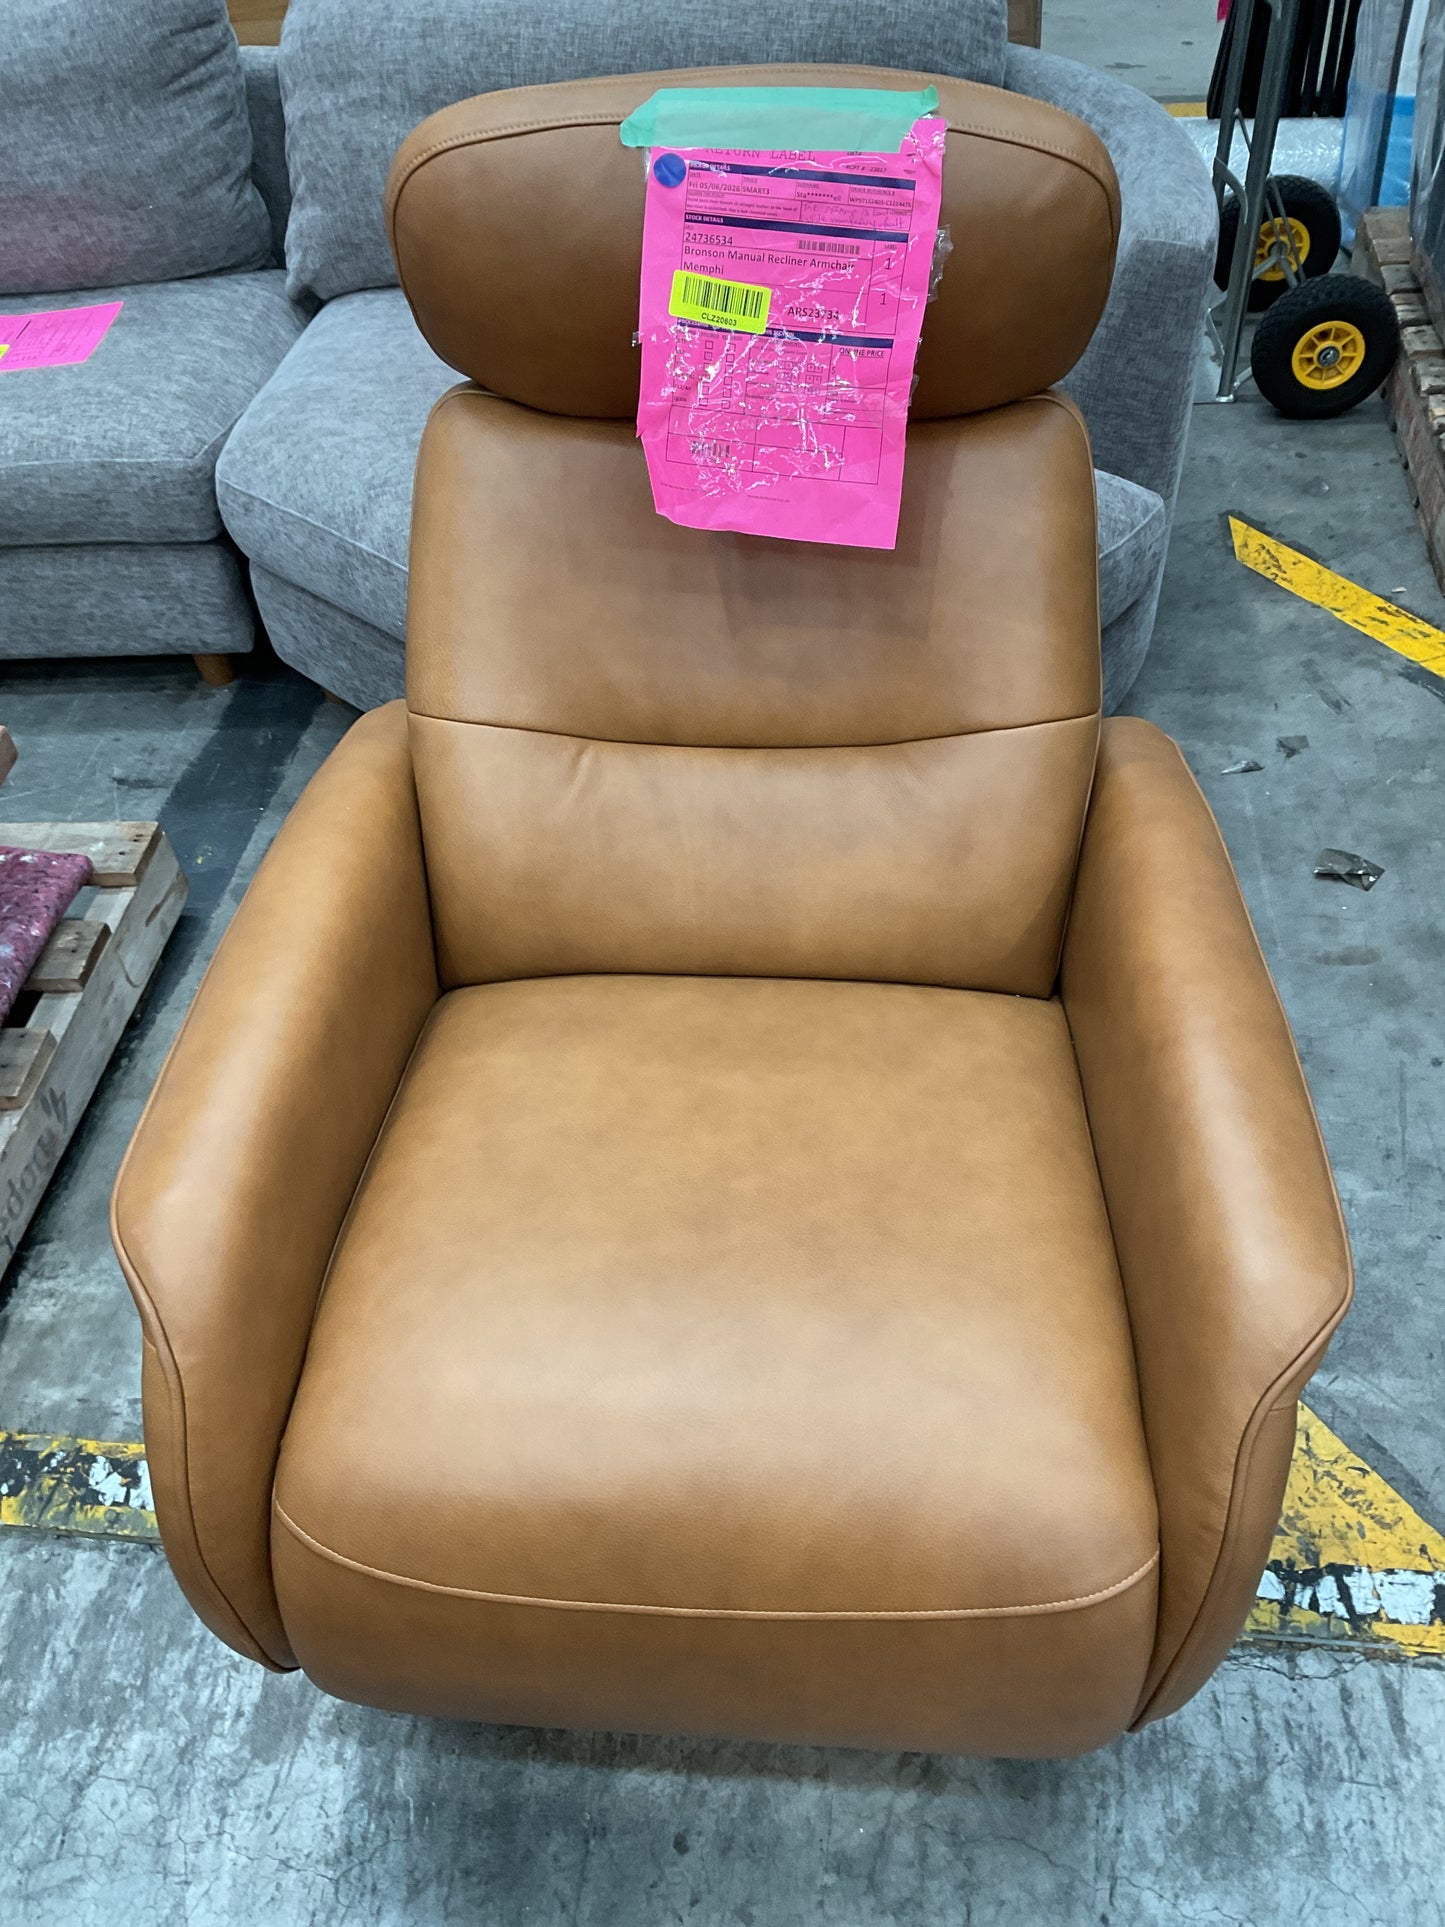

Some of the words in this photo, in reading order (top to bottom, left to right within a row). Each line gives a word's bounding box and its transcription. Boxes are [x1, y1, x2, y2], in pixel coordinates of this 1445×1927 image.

[699, 182, 741, 192] 05/06/2026
[743, 186, 769, 195] SMART3
[703, 215, 724, 223] DETAILS
[685, 232, 733, 245] 24736534
[684, 245, 725, 259] Bronson
[727, 250, 765, 262] Manual
[767, 255, 807, 267] Recliner
[809, 259, 854, 270] Armchair
[885, 257, 892, 270] 1
[683, 261, 724, 275] Memphi
[880, 293, 887, 305] 1
[701, 312, 737, 326] CLZ20603
[866, 349, 884, 358] PRICE
